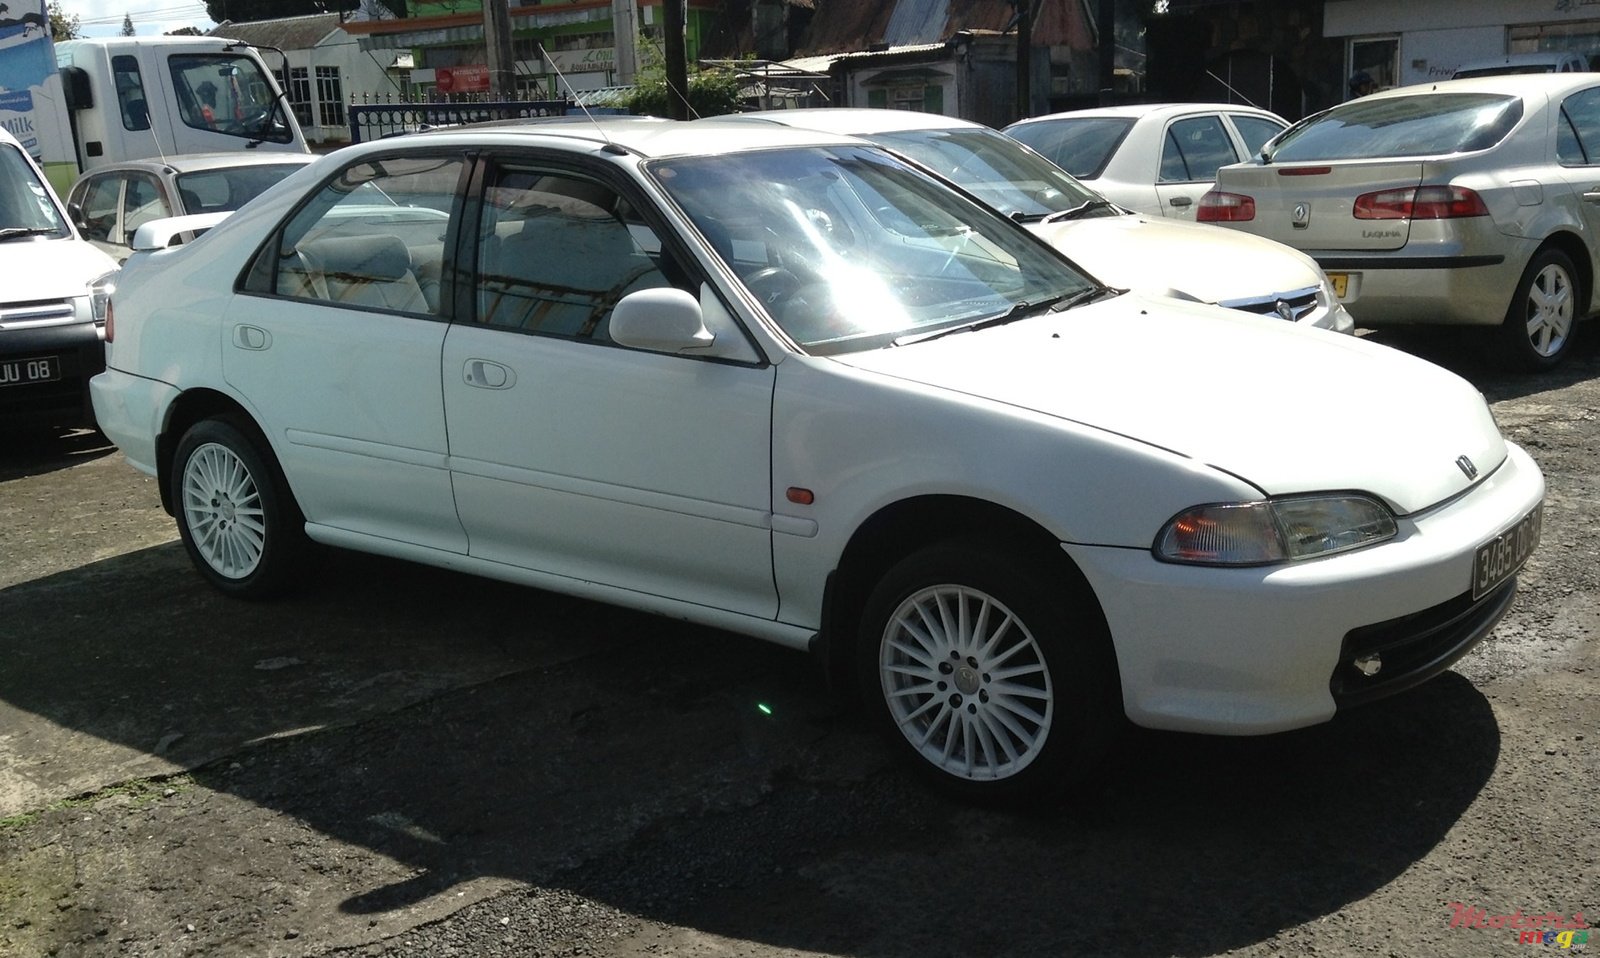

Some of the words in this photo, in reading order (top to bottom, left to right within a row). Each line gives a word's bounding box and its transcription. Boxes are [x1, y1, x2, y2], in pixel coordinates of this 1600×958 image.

[1, 116, 35, 135] Milk
[28, 361, 50, 379] 08
[1480, 533, 1513, 588] 3485
